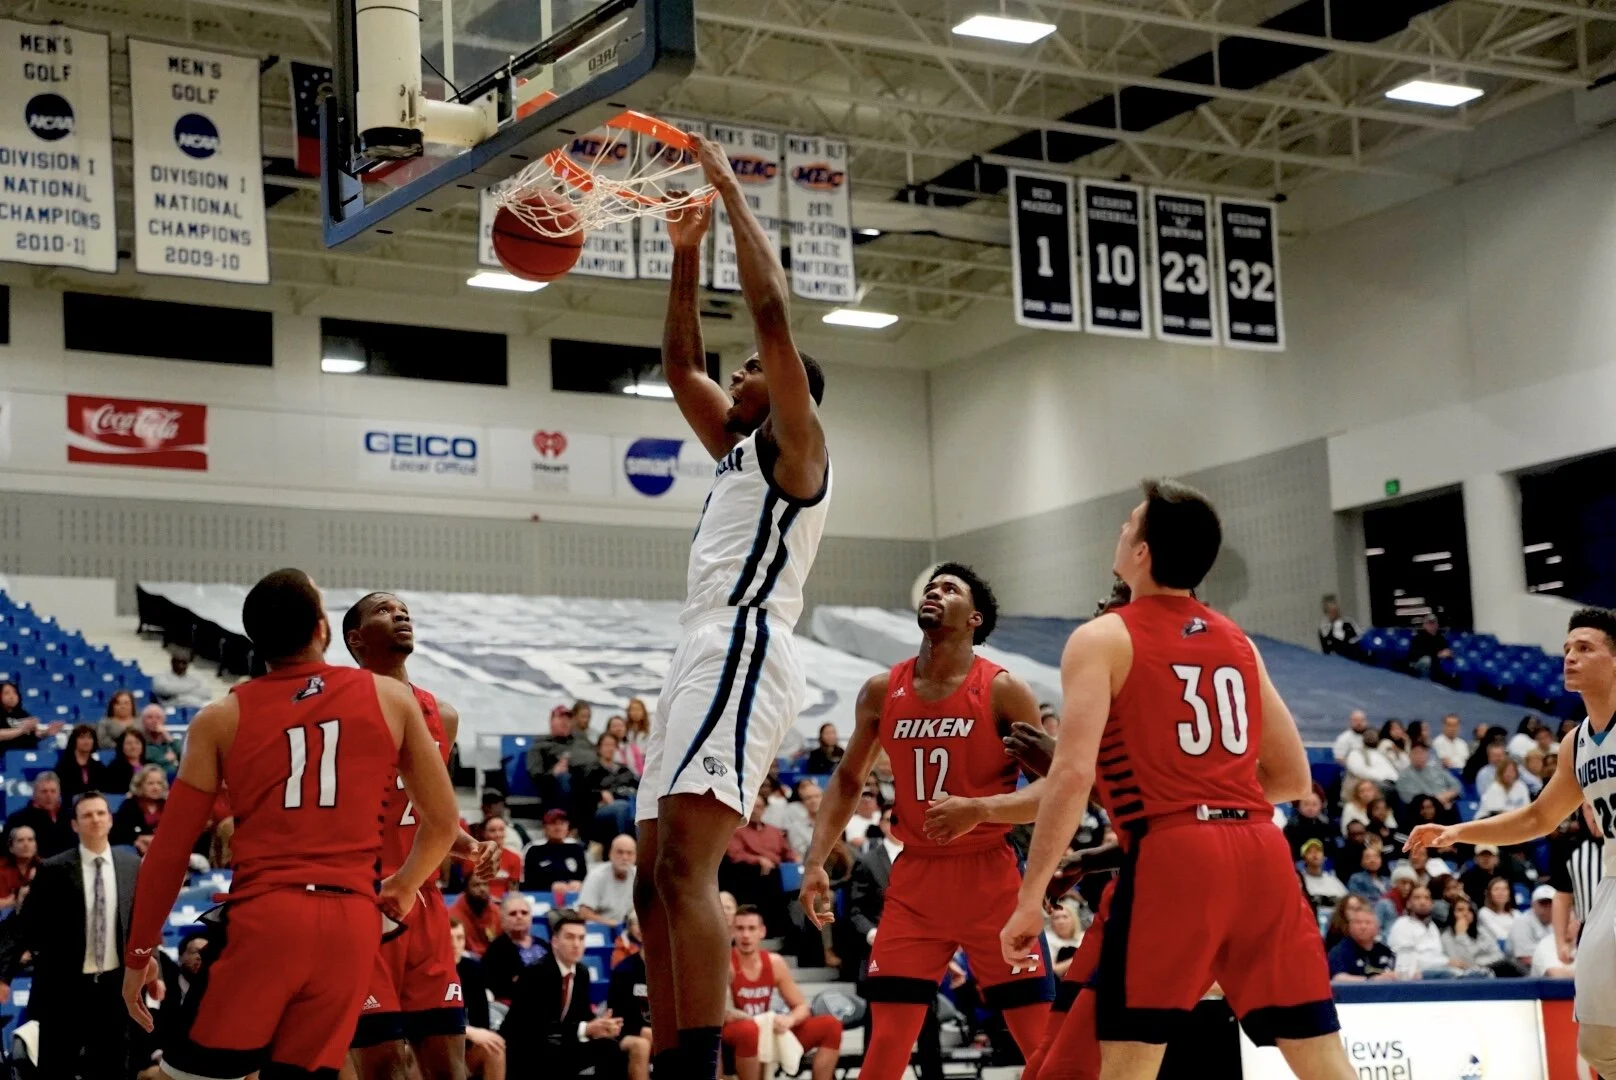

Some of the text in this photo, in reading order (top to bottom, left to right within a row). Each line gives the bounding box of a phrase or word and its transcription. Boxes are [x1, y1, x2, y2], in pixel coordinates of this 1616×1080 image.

[20, 34, 73, 55] MEN'S
[24, 62, 71, 82] GOLF
[168, 56, 222, 80] MEN'S
[172, 83, 219, 105] GOLF
[0, 147, 80, 172] DIVISION
[3, 176, 92, 203] NATIONAL
[150, 165, 228, 190] DIVISION
[0, 202, 101, 231] CHAMPIONS
[154, 192, 243, 219] NATIONAL
[16, 231, 86, 256] 2010-11
[148, 218, 252, 247] CHAMPIONS
[164, 245, 241, 271] 2009-10
[1036, 236, 1054, 278] 1
[1096, 243, 1136, 286] 10
[1161, 250, 1209, 295] 23
[1228, 258, 1275, 302] 32
[364, 431, 477, 459] GEICO
[390, 456, 477, 476] Local Office
[1171, 664, 1249, 757] 30
[893, 717, 975, 739] AIKEN
[284, 719, 340, 808] 11
[913, 747, 949, 801] 12
[444, 983, 463, 1002] A
